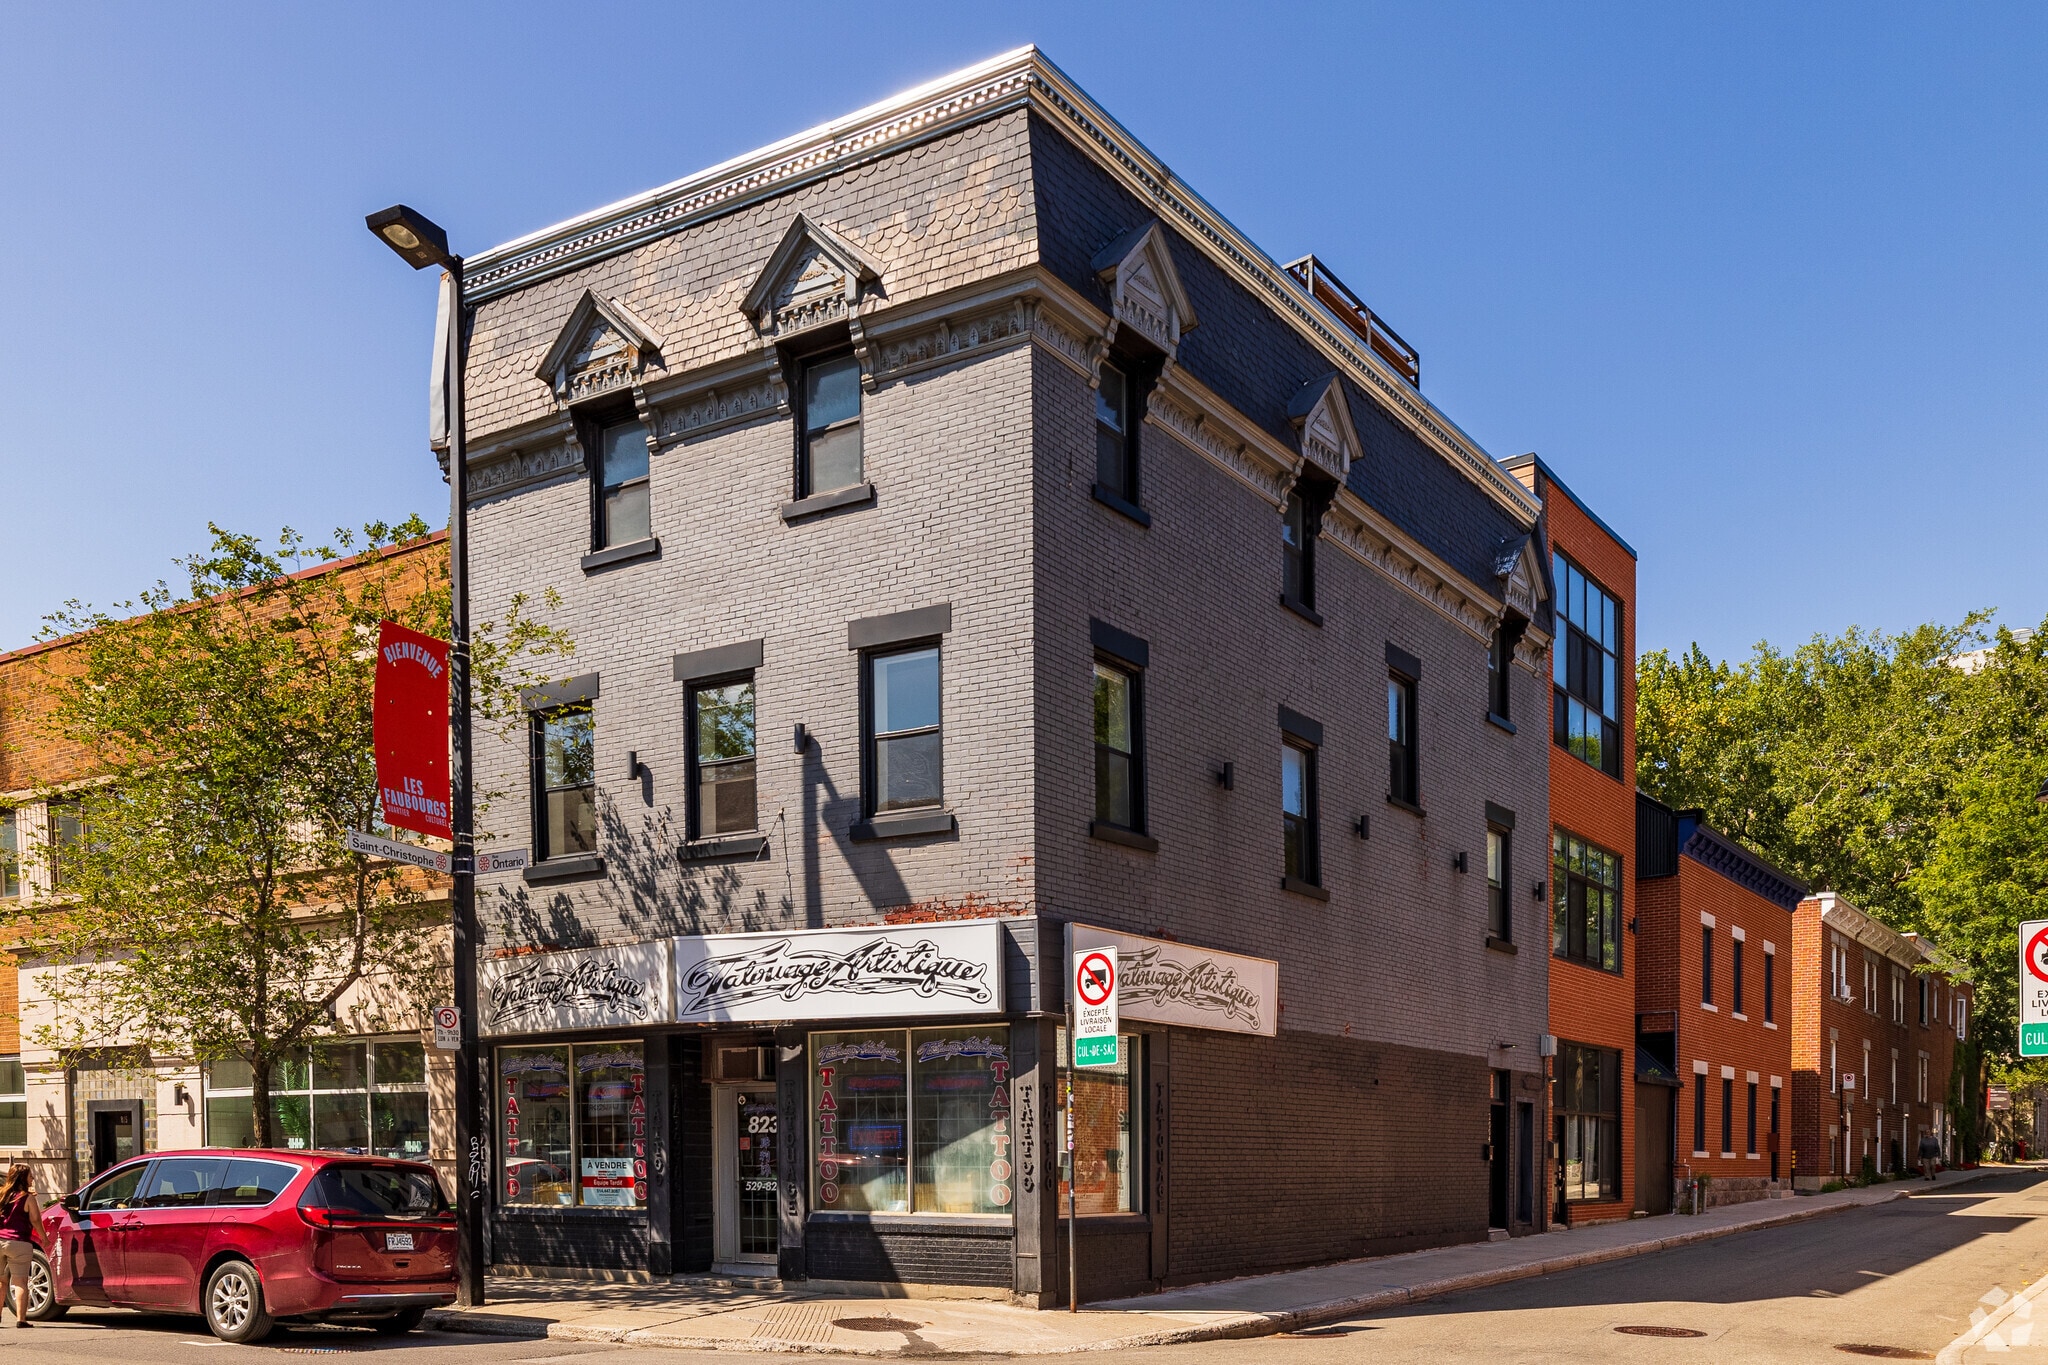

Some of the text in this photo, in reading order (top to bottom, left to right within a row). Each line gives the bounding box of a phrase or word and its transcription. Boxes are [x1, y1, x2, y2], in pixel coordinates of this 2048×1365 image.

[383, 641, 444, 679] BIENVENUE
[403, 776, 424, 796] LES
[383, 787, 447, 819] FAUBOURGS
[386, 804, 410, 817] QUARTIER
[425, 814, 448, 827] CULTUREL
[352, 838, 434, 866] Saint-Christophe
[492, 856, 524, 869] Ontario
[685, 938, 985, 1000] Tatouage Artistique
[491, 957, 642, 1012] Tatouage Artistique
[1172, 959, 1258, 1015] Artistique
[1080, 1016, 1112, 1026] LIVRAISON
[1083, 1005, 1109, 1017] EXCEPTÉ
[2041, 1008, 2048, 1016] L
[1085, 1025, 1107, 1034] LOCALE
[1077, 1043, 1115, 1057] CUL-DE-SAC
[748, 1116, 777, 1133] 823
[818, 1066, 839, 1203] TATTOO
[989, 1061, 1012, 1206] TATTOO
[630, 1074, 647, 1200] TATTOO
[1155, 1082, 1165, 1214] TATOUAGE
[587, 1160, 627, 1169] À VENDRE
